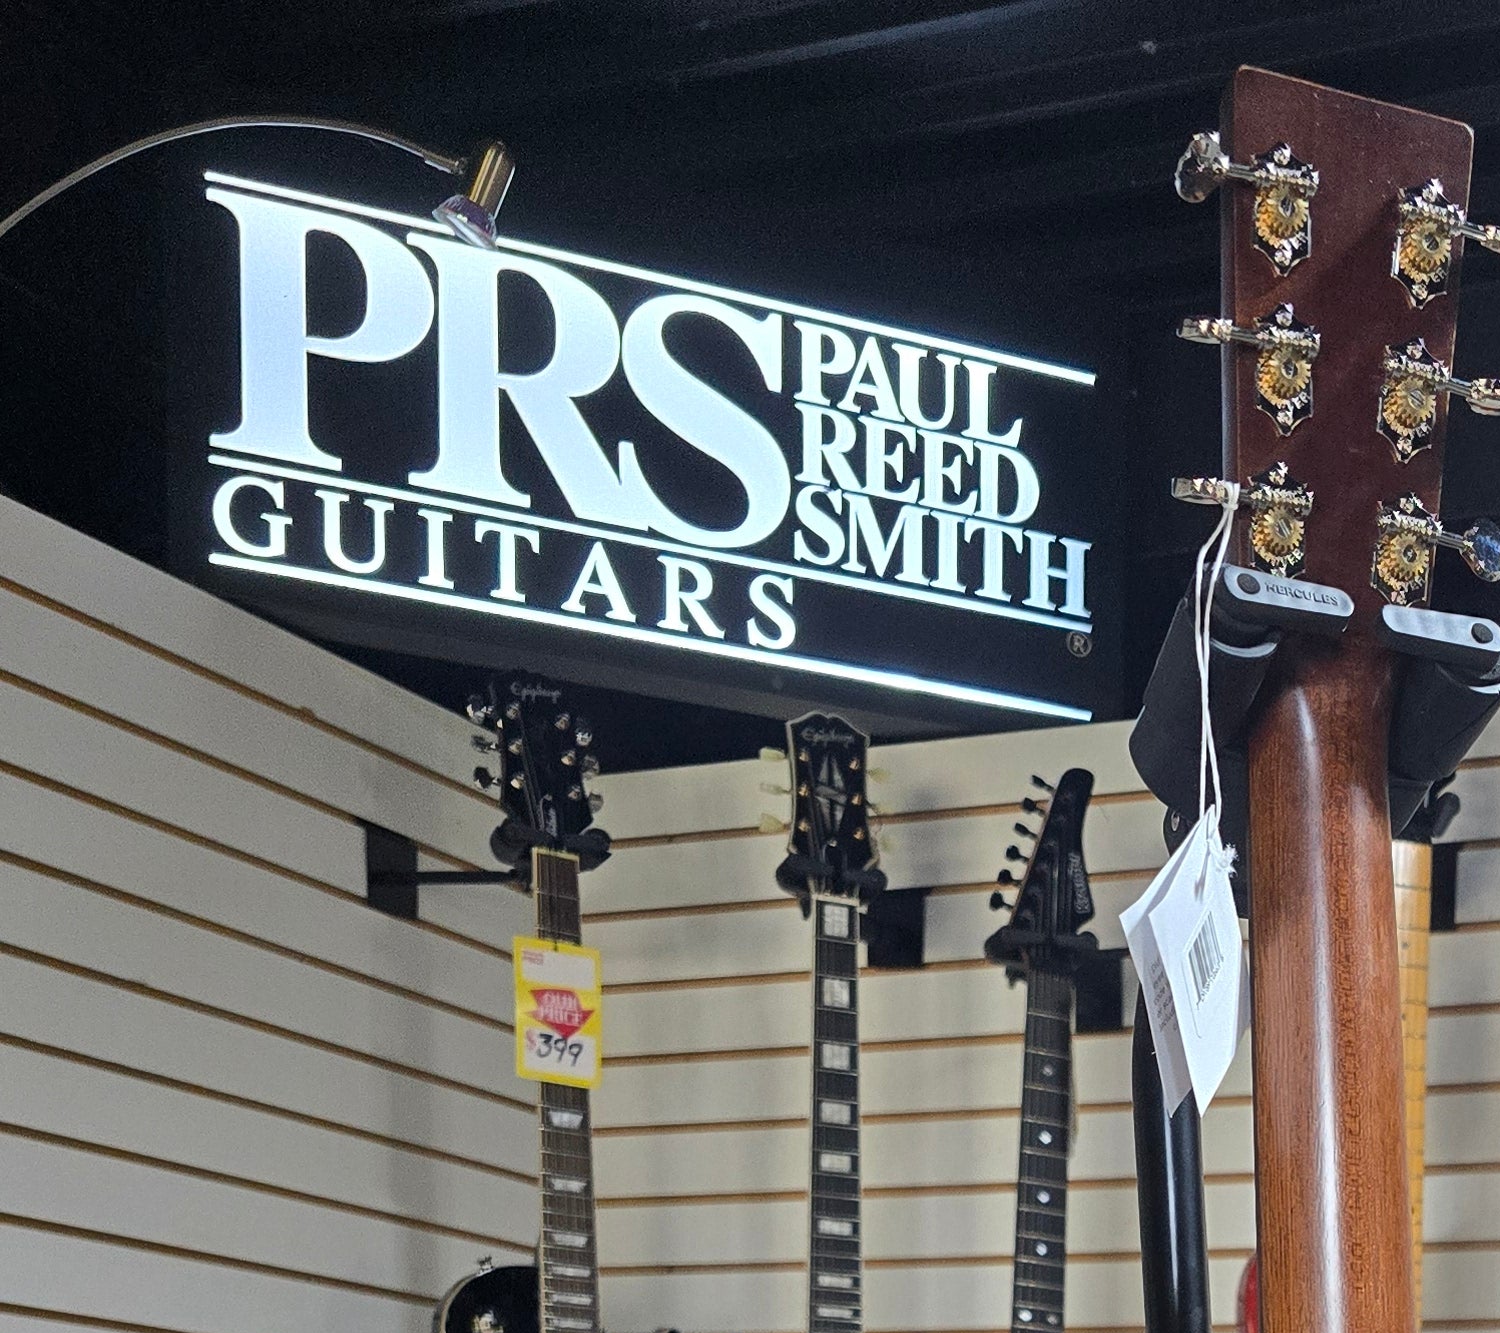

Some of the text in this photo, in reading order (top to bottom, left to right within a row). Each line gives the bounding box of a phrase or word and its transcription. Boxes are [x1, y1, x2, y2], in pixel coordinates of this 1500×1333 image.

[206, 187, 791, 548] PRS
[793, 320, 1022, 448] PAUL
[794, 402, 1041, 526] REED
[211, 474, 797, 650] GUITARS
[793, 486, 1092, 619] SMITH
[1265, 582, 1339, 606] HERCULES
[510, 681, 561, 704] Epiphone
[537, 1005, 583, 1027] PRICE
[542, 992, 579, 1011] OUR
